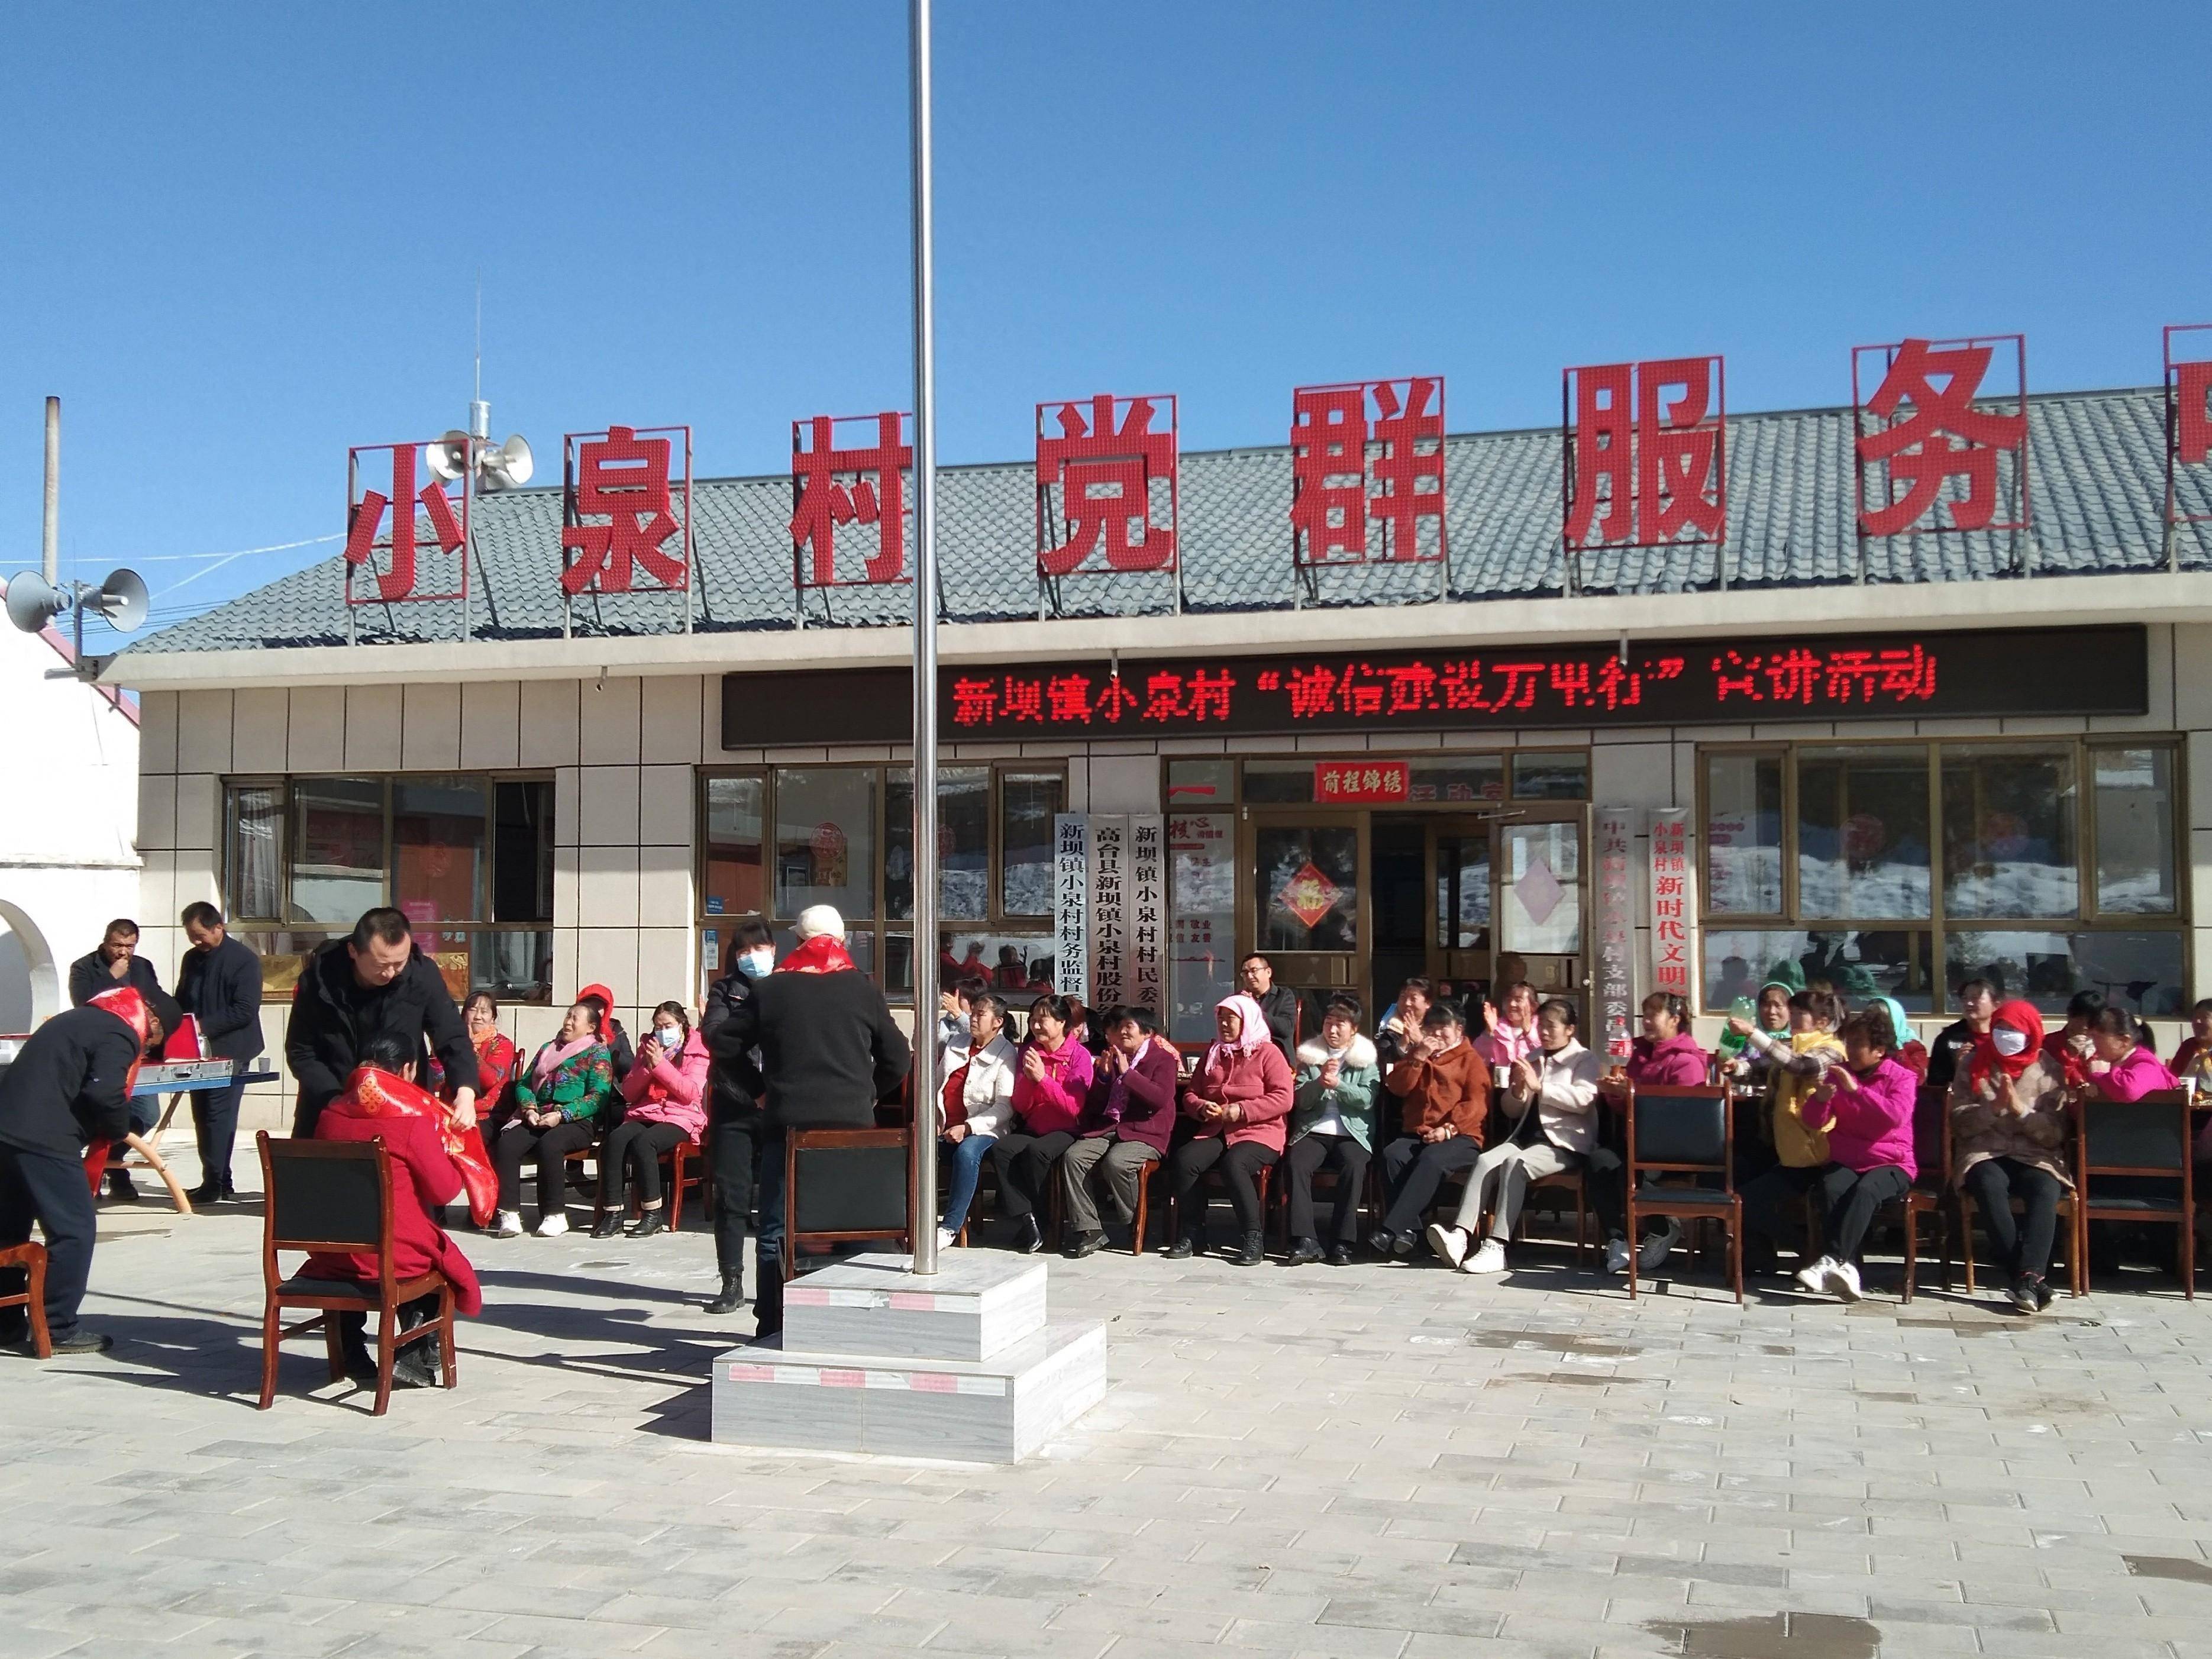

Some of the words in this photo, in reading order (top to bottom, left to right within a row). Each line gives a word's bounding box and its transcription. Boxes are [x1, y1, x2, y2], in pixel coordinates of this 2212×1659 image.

[1135, 826, 1158, 1013] 新坝镇小泉村村民委
[1656, 876, 1686, 995] 新时代文明
